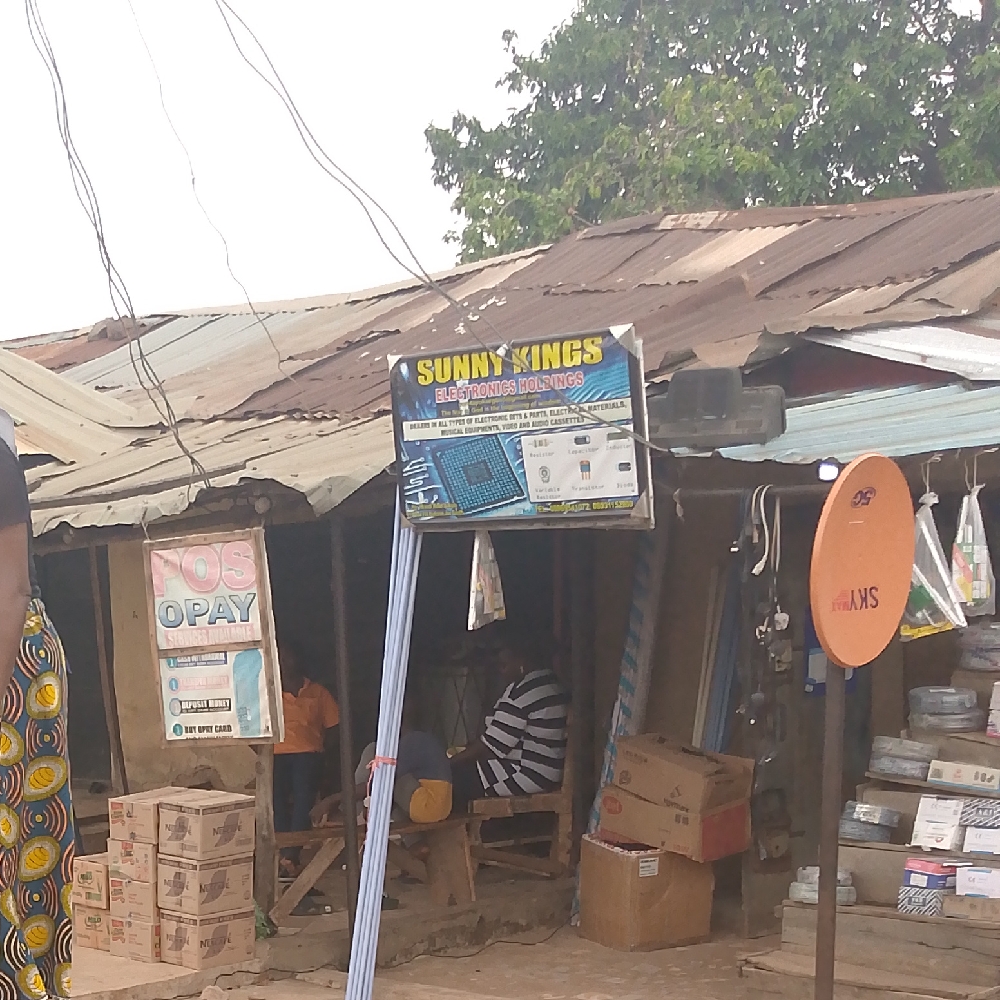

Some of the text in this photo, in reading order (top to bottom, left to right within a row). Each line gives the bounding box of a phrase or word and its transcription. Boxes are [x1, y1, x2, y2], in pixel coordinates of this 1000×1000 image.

[416, 336, 603, 386] SUNNY KINGS
[435, 379, 516, 404] ELECTRONICS
[518, 371, 584, 395] HOLDINGS
[448, 419, 465, 427] TYPES
[474, 414, 508, 424] ELECTRONIC
[502, 423, 517, 431] VIDEO
[519, 421, 530, 429] AND
[531, 419, 549, 428] AUDIO
[550, 416, 584, 426] CASSETTES
[151, 540, 257, 598] POS
[158, 592, 257, 629] OPAY
[850, 586, 879, 611] SKY
[214, 724, 232, 733] CARD
